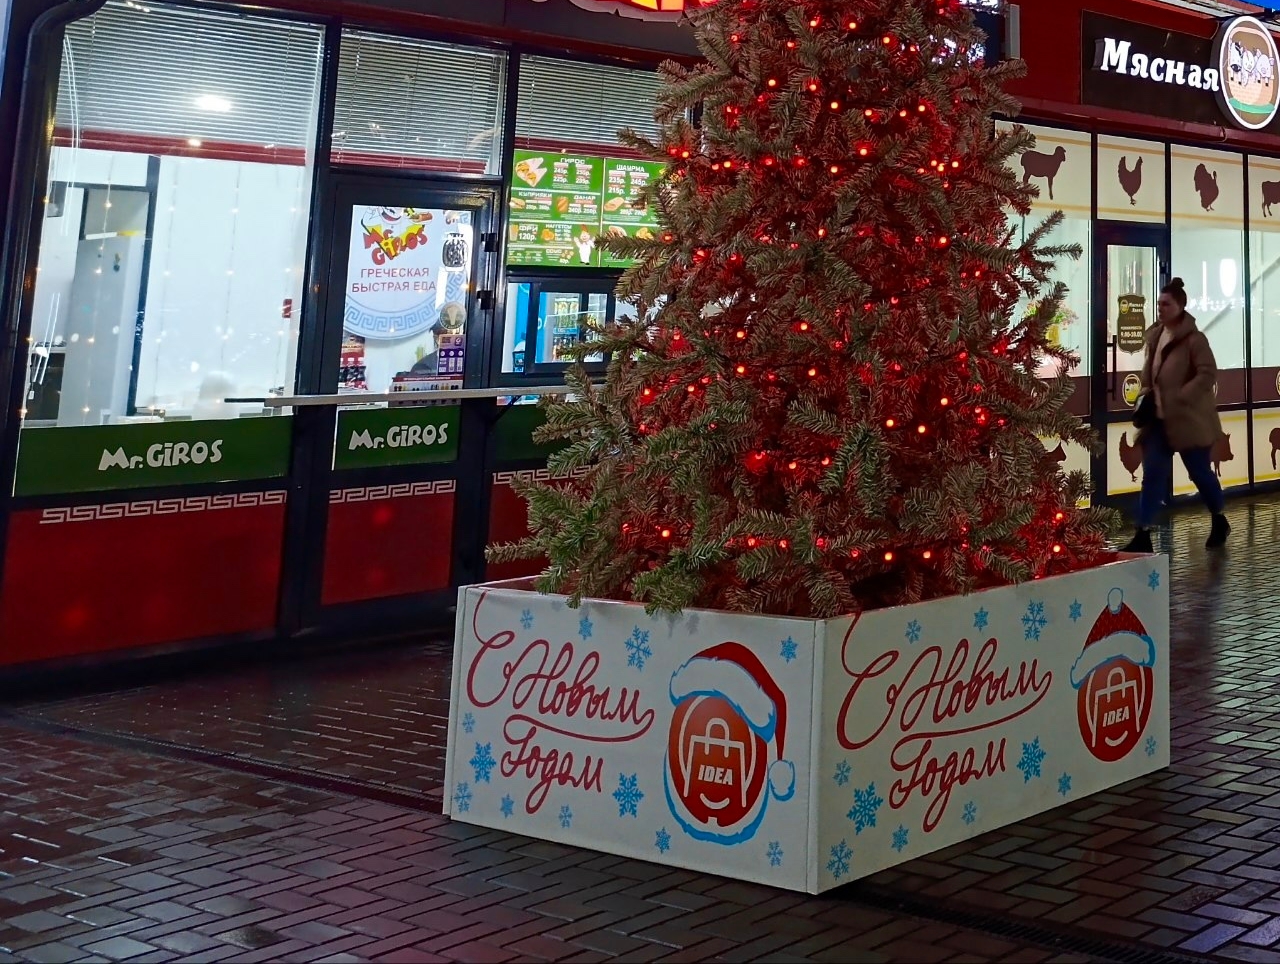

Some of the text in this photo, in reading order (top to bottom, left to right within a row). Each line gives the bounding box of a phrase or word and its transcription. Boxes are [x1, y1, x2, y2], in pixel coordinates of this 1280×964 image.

[1100, 37, 1220, 92] Мясная
[352, 281, 437, 293] БЫСТРАЯ ЕДА
[361, 267, 430, 278] ГРЕЧЕСКАЯ
[509, 638, 654, 726] Новым
[898, 637, 1052, 732] Новым
[1102, 704, 1130, 728] IDEA
[501, 713, 603, 814] Годом
[697, 763, 733, 786] IDEA
[889, 732, 1006, 833] Годом
